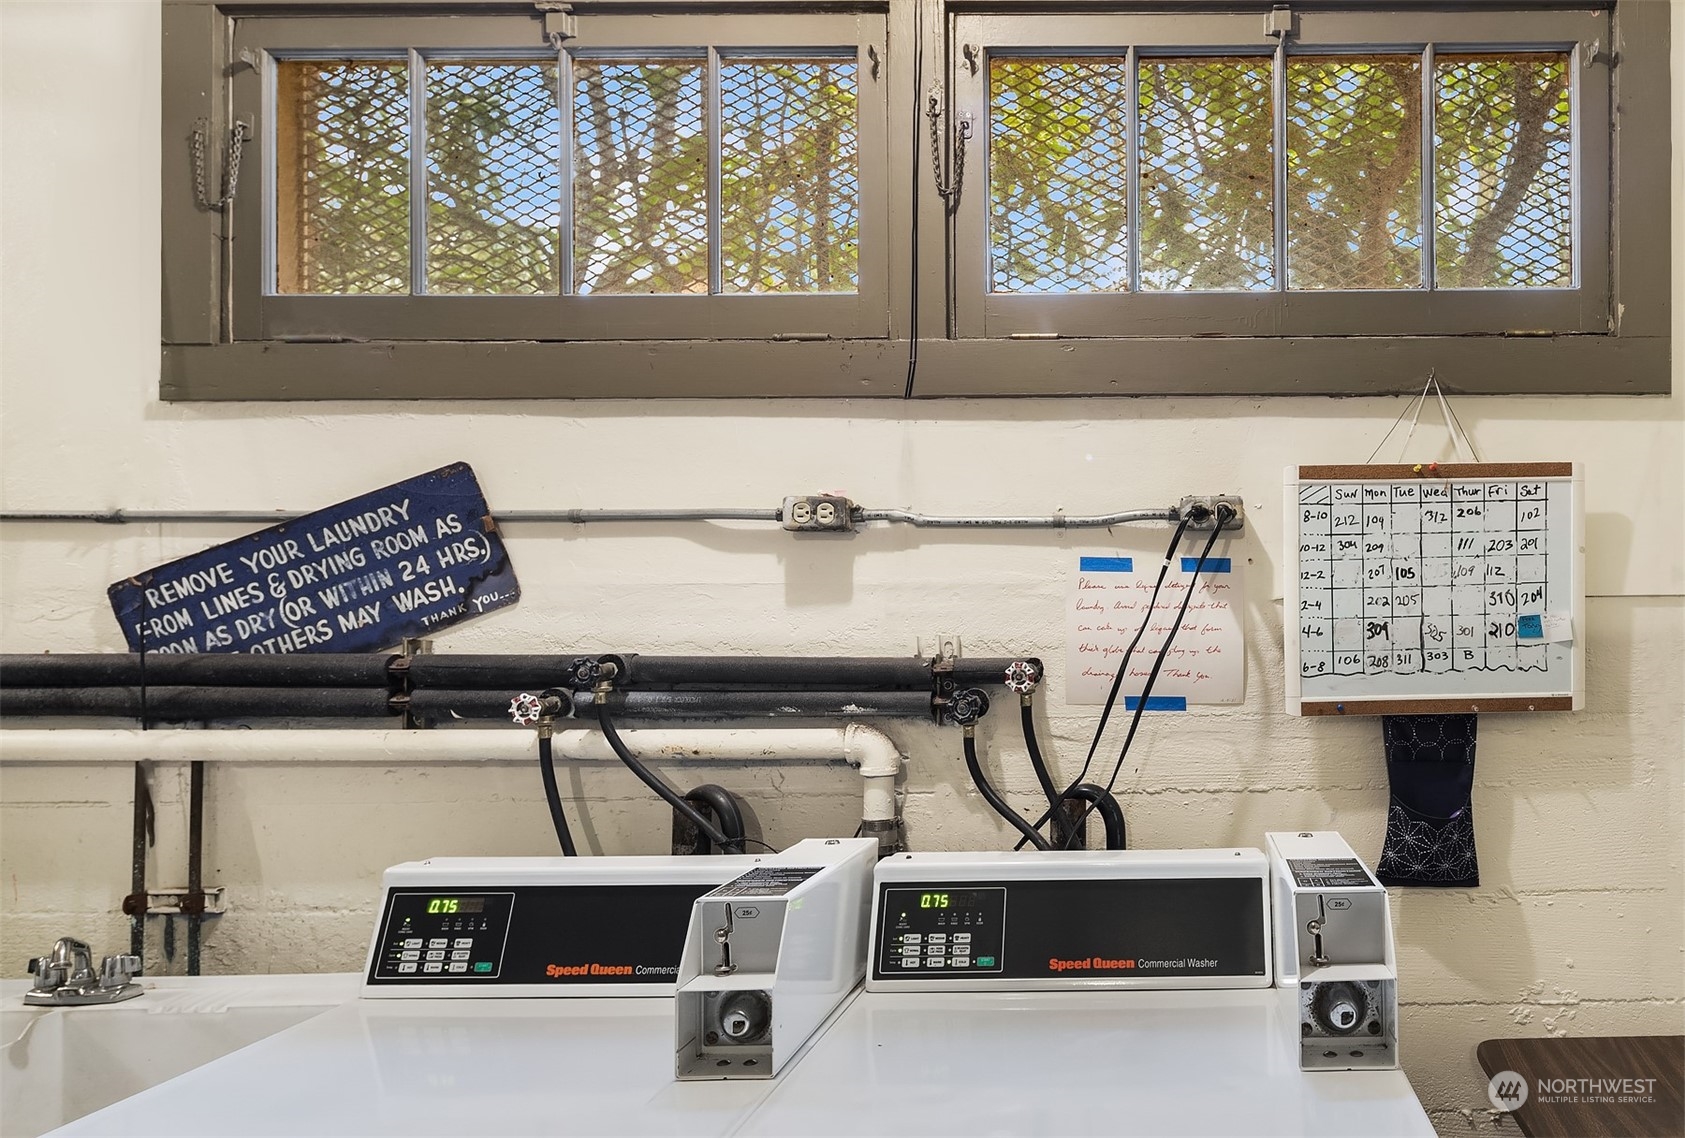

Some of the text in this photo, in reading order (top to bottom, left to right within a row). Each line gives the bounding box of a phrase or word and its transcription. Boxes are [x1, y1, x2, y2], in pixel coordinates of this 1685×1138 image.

[1393, 486, 1415, 497] Tue
[1454, 486, 1481, 496] Thur
[1488, 484, 1508, 497] Fri
[1520, 485, 1541, 497] Sat
[1303, 510, 1328, 522] 8-10
[1334, 514, 1360, 527] 212
[1425, 510, 1448, 523] 312
[1457, 506, 1481, 517] 206
[1521, 507, 1540, 522] 102
[145, 498, 410, 608] REMOVE YOUR LAUNDRY
[1299, 544, 1325, 552] 10-12
[1457, 537, 1474, 551] 111
[1487, 540, 1514, 552] 203
[135, 513, 463, 643] FROM LINES & DRYING ROOM AS
[1300, 570, 1326, 580] 12-2
[1367, 564, 1385, 579] 207
[1395, 567, 1416, 580] 105
[1486, 564, 1505, 576] 112
[205, 625, 233, 651] AS
[235, 607, 276, 640] DRY
[318, 568, 394, 610] WITHIN
[398, 555, 430, 582] 24
[337, 601, 380, 634] MAY
[391, 575, 465, 613] WASH.
[1300, 600, 1322, 611] 2-4
[1395, 593, 1420, 606] 205
[1520, 586, 1543, 606] 204
[420, 603, 468, 626] THANK
[1301, 624, 1324, 638] 4-6
[1456, 625, 1474, 637] 301
[1488, 622, 1515, 638] 210
[1302, 650, 1475, 672] 6-8 106 208 311 303 B
[546, 963, 680, 978] Speed Queen Commercia
[1049, 957, 1218, 971] Speed Queen Commercial Washer
